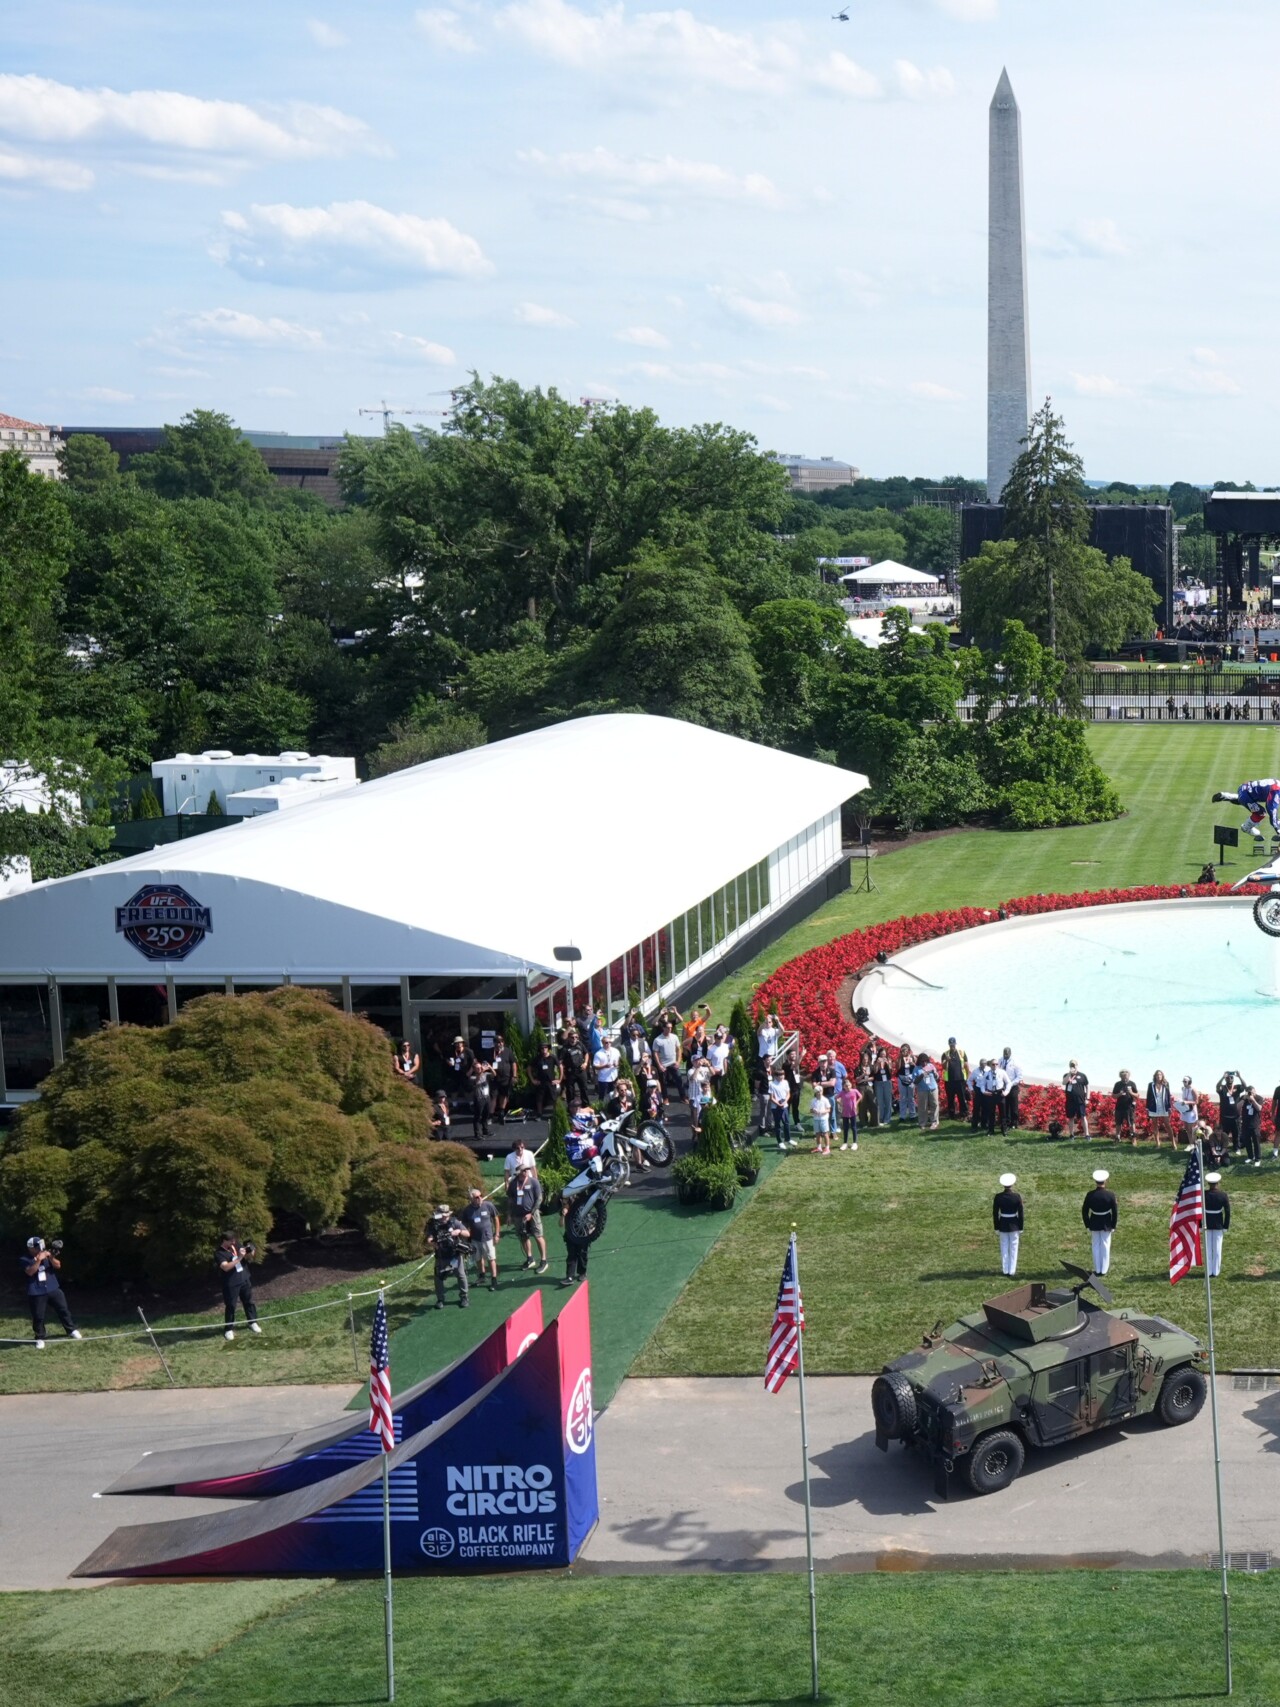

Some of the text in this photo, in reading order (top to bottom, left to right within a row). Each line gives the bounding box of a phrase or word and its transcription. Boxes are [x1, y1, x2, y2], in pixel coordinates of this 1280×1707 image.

[150, 897, 175, 906] UFC
[116, 907, 212, 928] FREEDOM
[146, 928, 185, 946] 250
[446, 1464, 553, 1491] NITRO
[446, 1490, 557, 1516] CIRCUS
[458, 1525, 509, 1544] BLACK
[460, 1543, 555, 1558] COFFEE COMPANY
